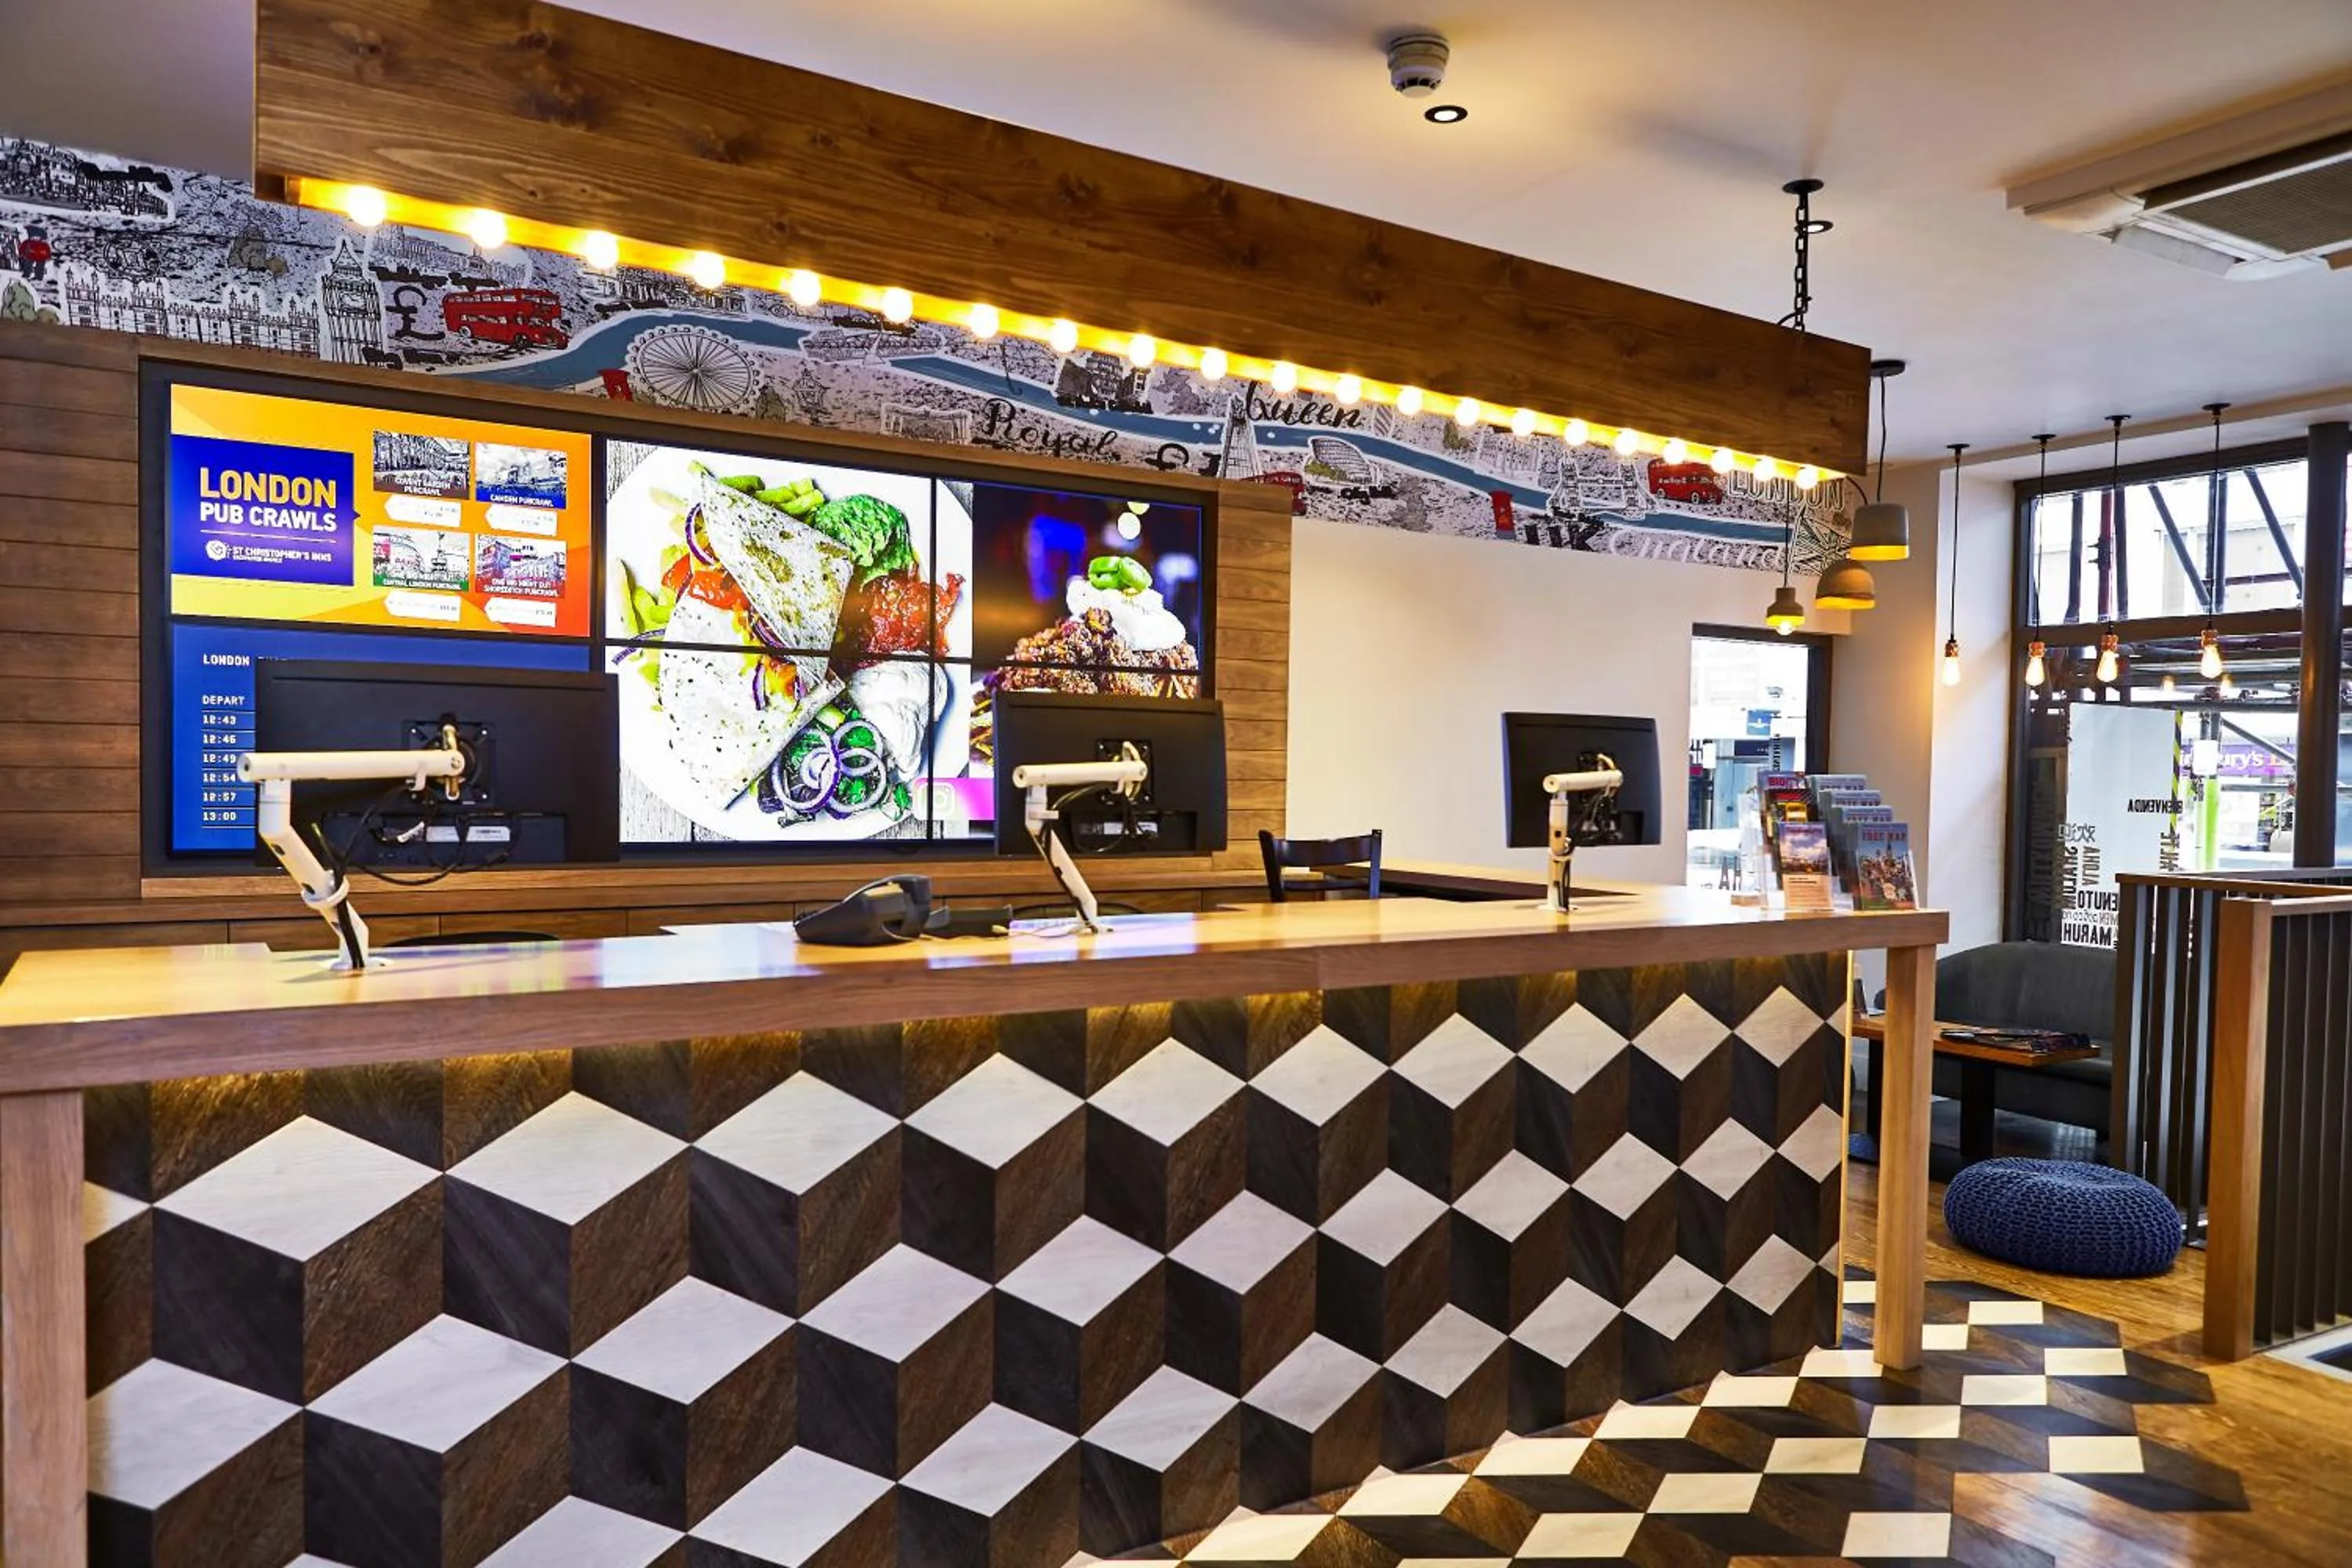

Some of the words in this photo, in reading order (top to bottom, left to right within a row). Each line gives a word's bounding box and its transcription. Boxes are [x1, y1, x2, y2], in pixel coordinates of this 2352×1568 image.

[1245, 379, 1362, 428] Queen
[981, 397, 1120, 458] Royal
[200, 467, 336, 509] LONDON
[200, 502, 244, 524] PUB
[249, 506, 337, 532] CRAWLS
[1609, 527, 1786, 568] England
[203, 653, 250, 666] LONDON
[202, 695, 245, 706] DEPART
[203, 792, 237, 802] 12:57
[203, 811, 237, 821] 13:00
